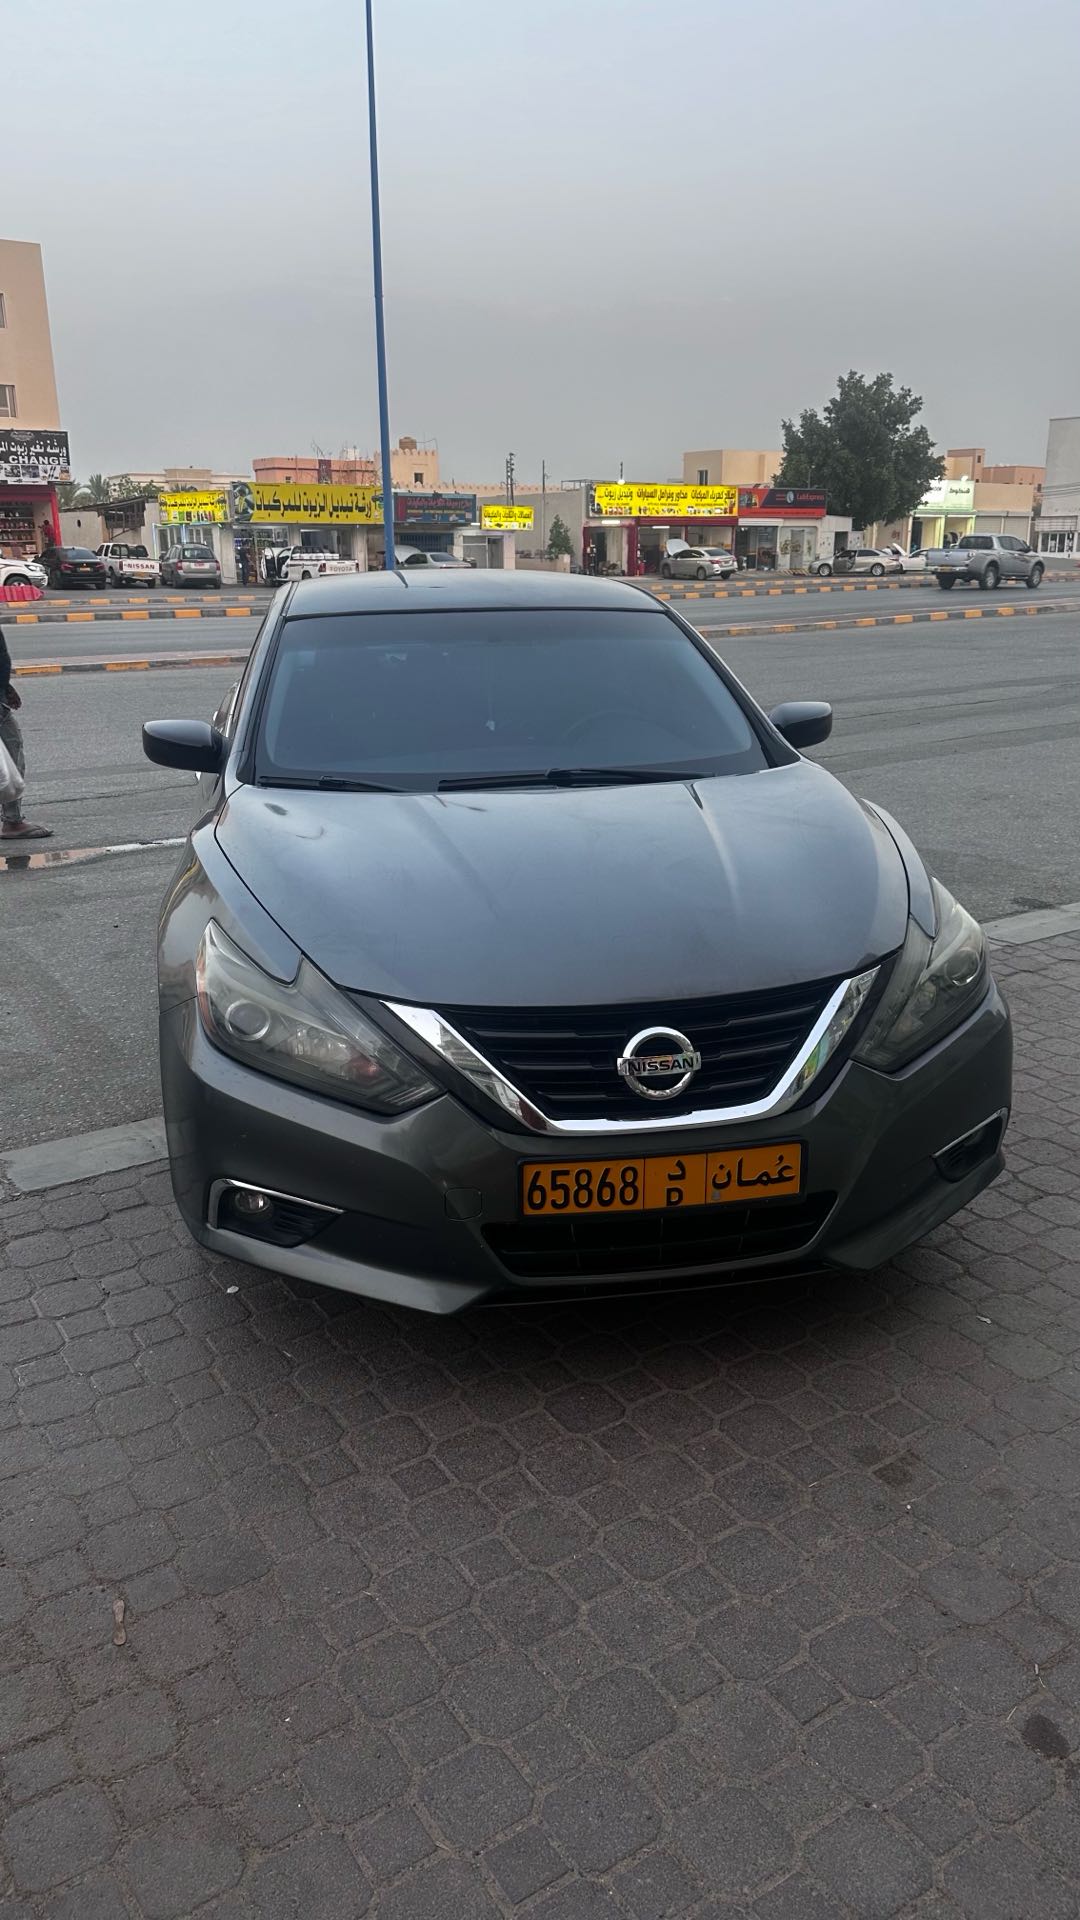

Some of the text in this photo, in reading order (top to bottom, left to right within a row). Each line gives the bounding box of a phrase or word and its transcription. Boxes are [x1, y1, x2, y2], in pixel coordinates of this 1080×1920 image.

[46, 439, 67, 457] ورشة
[9, 455, 68, 466] CHANGE
[256, 488, 302, 518] للمركبات
[628, 1058, 695, 1075] NISSAN
[667, 1159, 687, 1181] د
[527, 1165, 640, 1211] 65868
[666, 1187, 684, 1207] D
